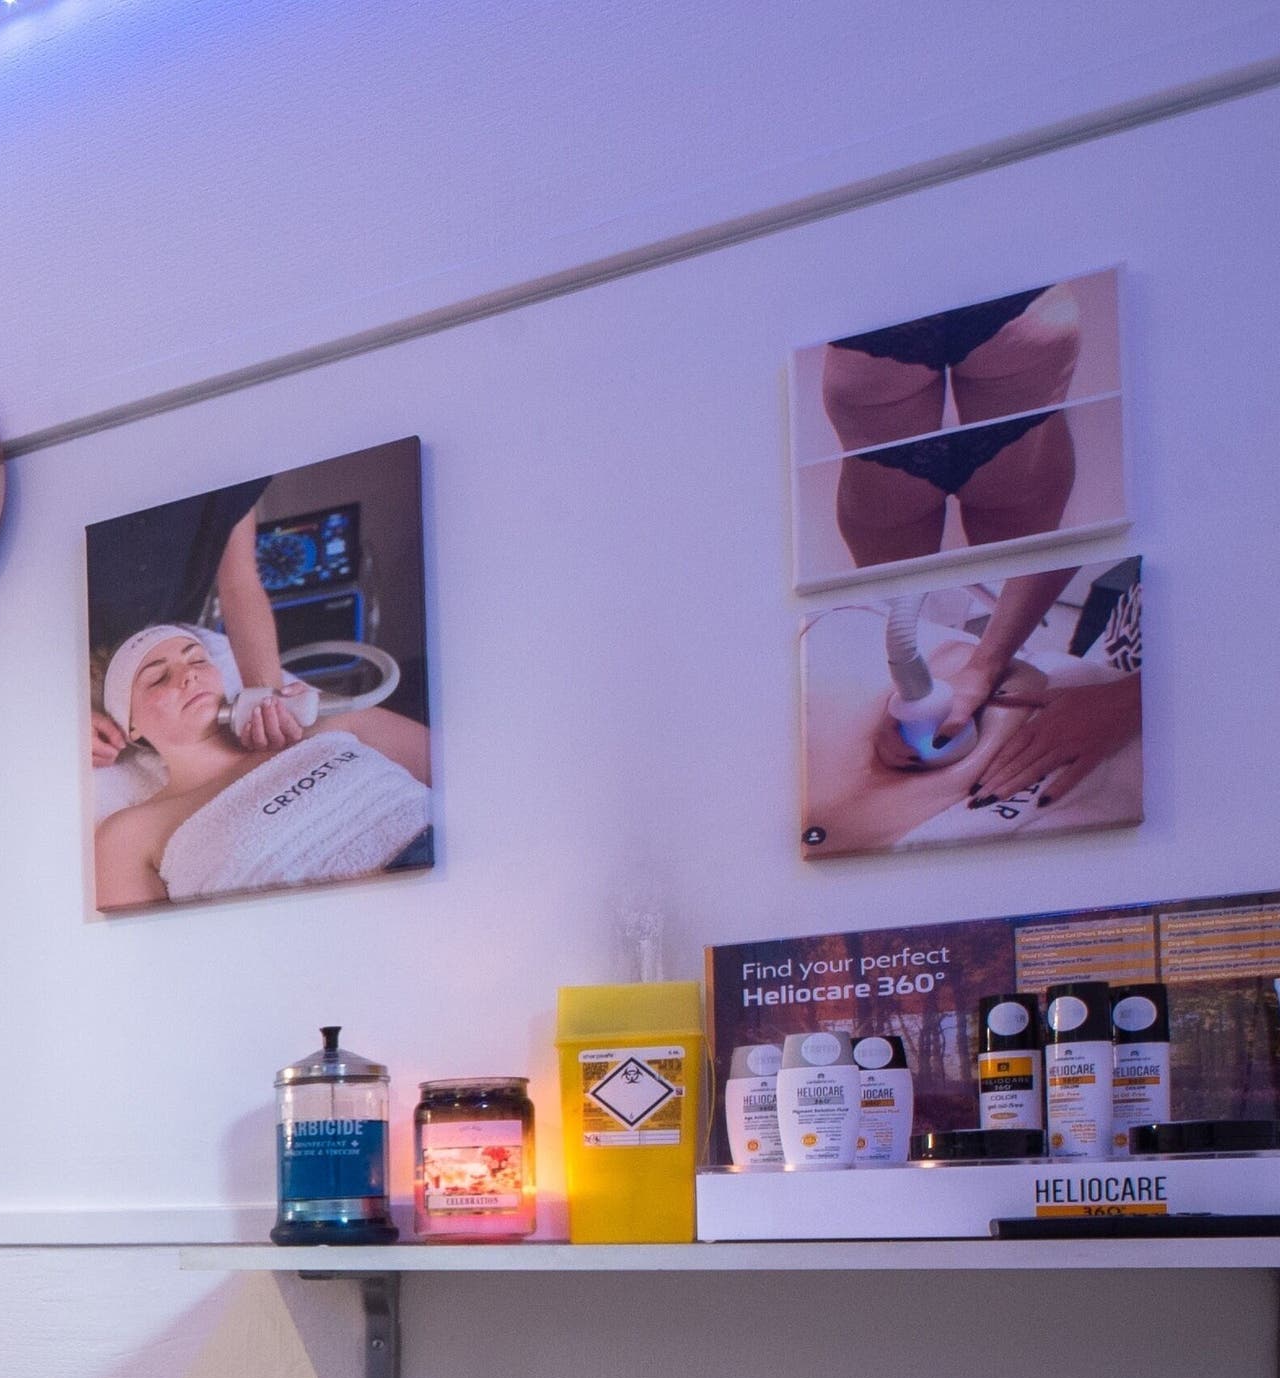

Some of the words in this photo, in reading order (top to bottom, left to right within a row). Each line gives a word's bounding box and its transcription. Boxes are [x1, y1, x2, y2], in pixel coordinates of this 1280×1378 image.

[743, 958, 792, 980] Find
[799, 957, 853, 981] your
[860, 947, 950, 975] perfect
[743, 983, 871, 1007] Heliocare
[878, 972, 944, 996] 360°
[797, 1086, 844, 1097] HELIOCARE
[285, 1119, 364, 1138] ARBICIDE
[1035, 1176, 1168, 1203] HELIOCARE
[446, 1197, 498, 1206] CELEBRATION
